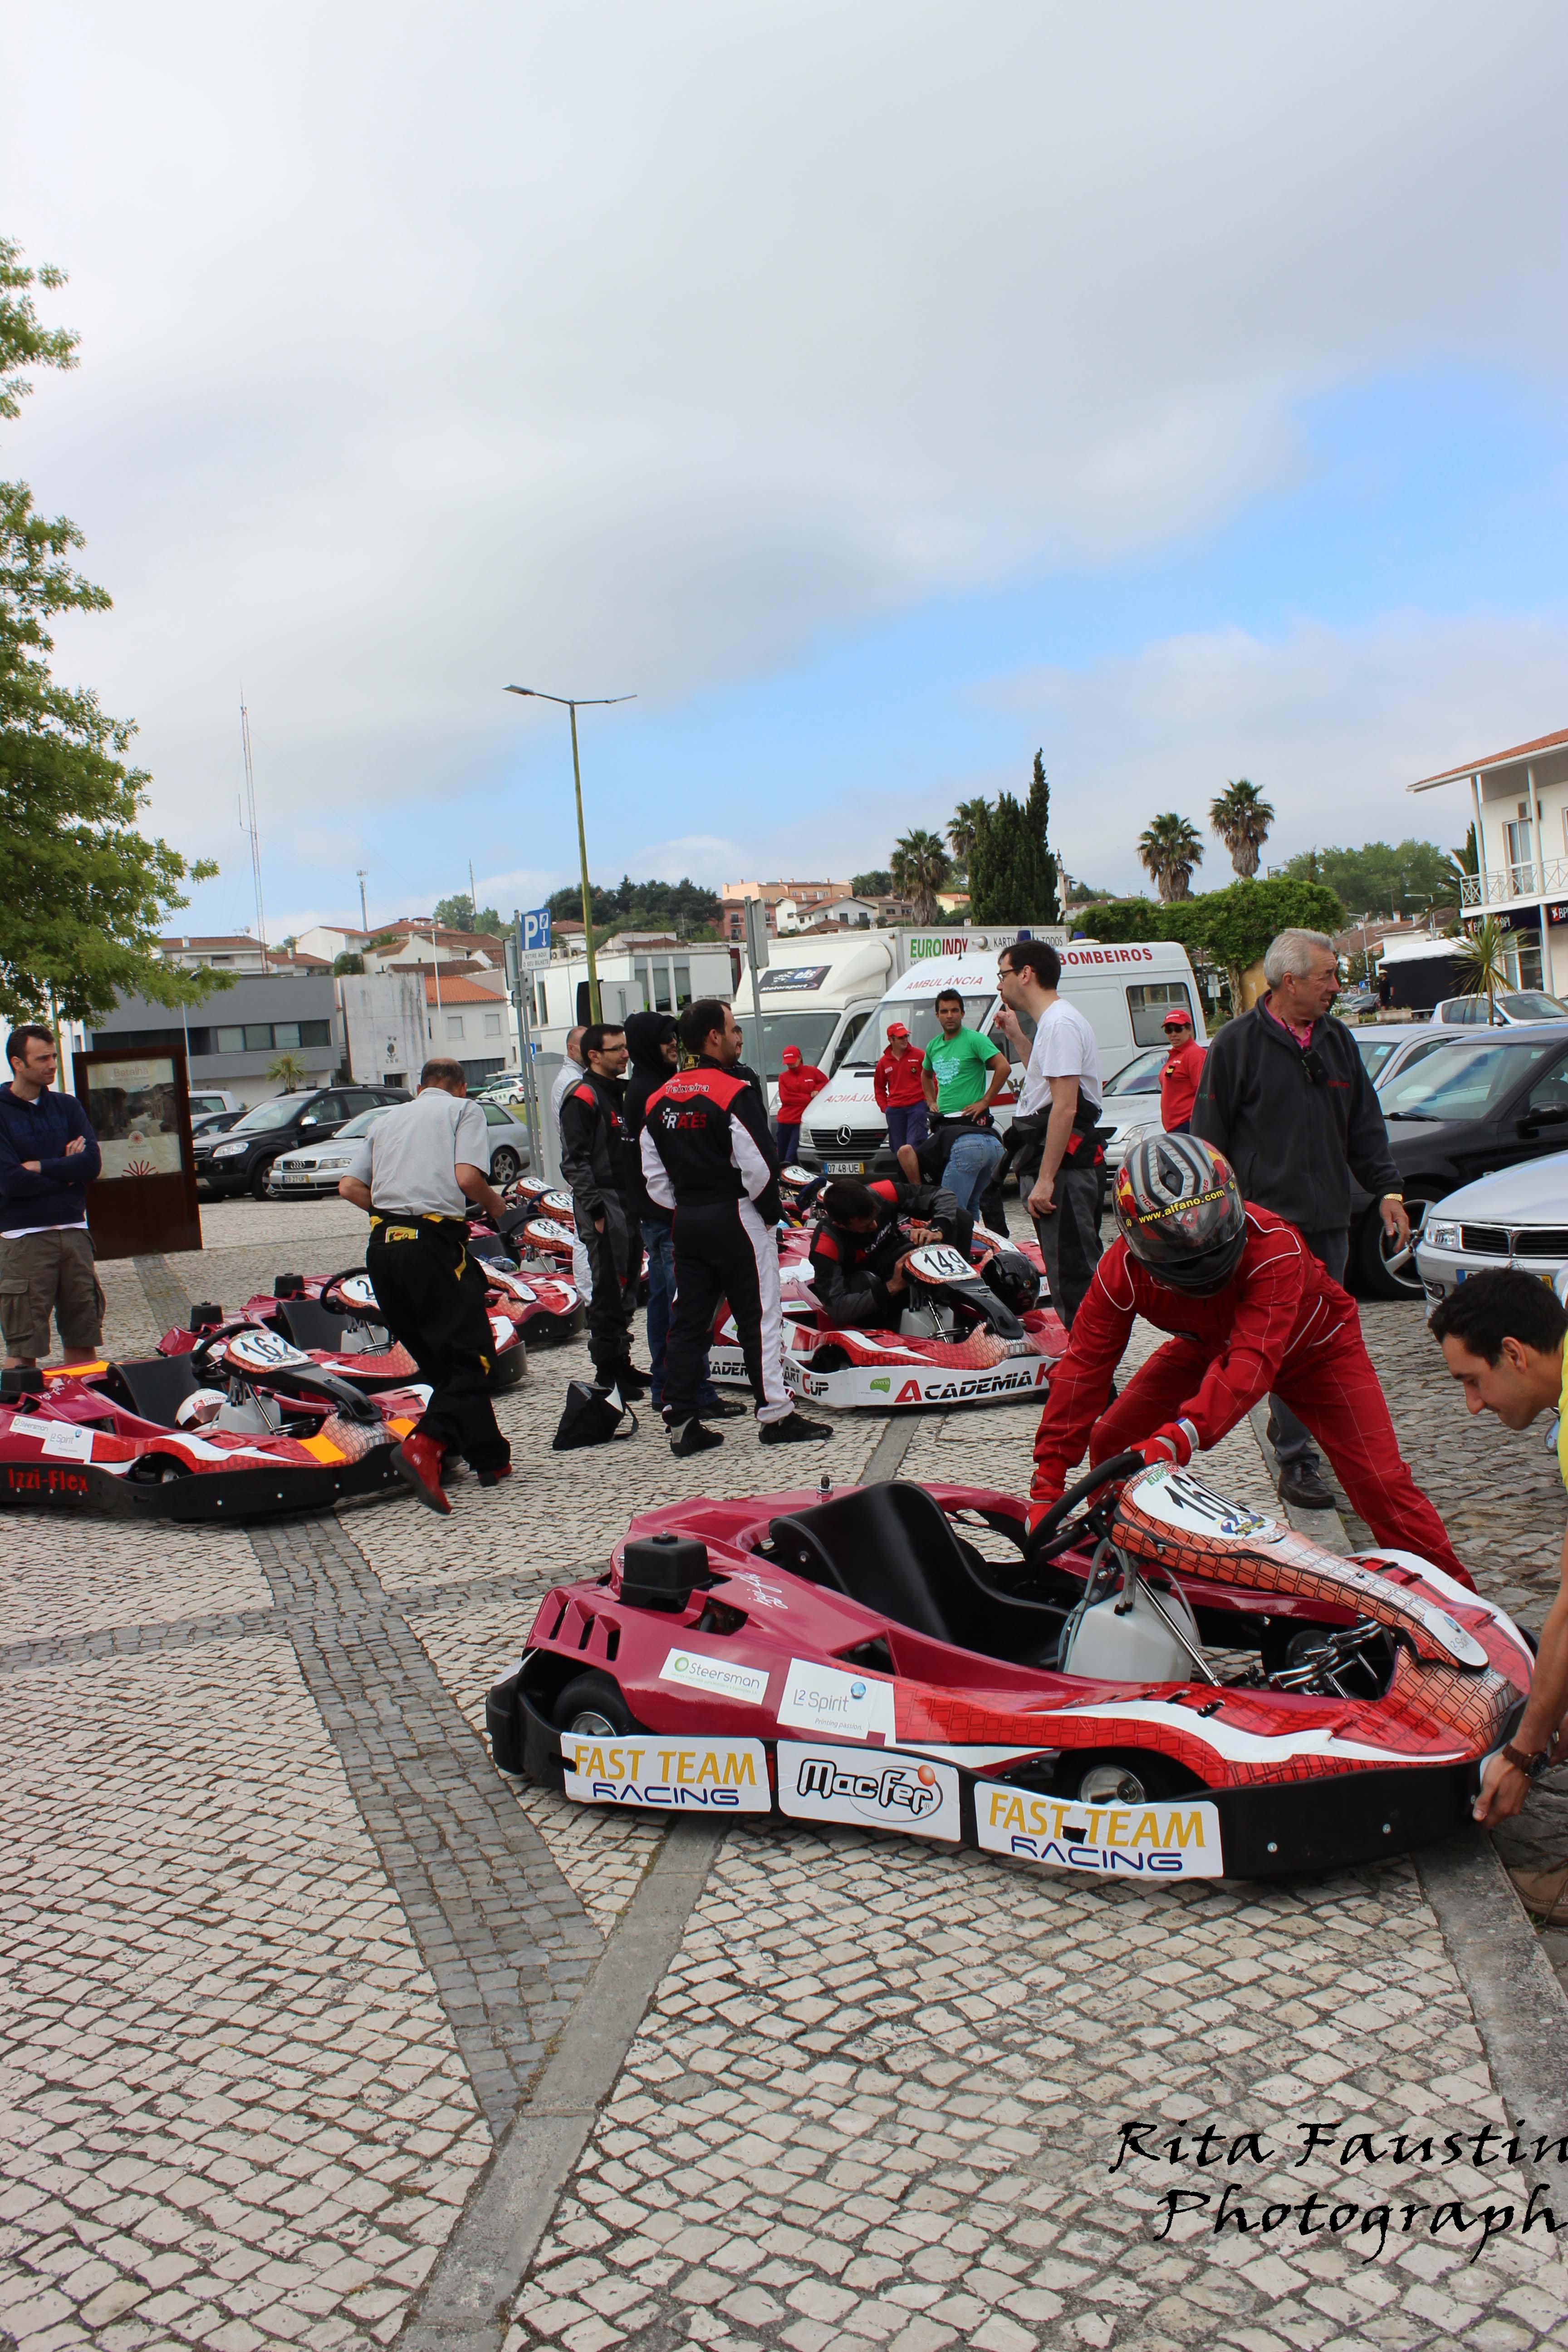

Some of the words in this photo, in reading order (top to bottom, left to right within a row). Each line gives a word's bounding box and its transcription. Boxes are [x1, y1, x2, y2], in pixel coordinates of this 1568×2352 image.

[1499, 916, 1510, 928] BPI
[911, 938, 968, 958] EUROINDY
[994, 936, 1017, 948] KARTIN
[1059, 948, 1153, 965] BOMBEIROS
[905, 975, 983, 991] AMBULÂNCIA
[113, 1067, 149, 1077] Batalha
[666, 1083, 709, 1094] Teixeira
[1139, 1188, 1225, 1224] www.alfano.com
[924, 1250, 967, 1273] 149
[240, 1336, 299, 1358] 162
[803, 1373, 829, 1396] CUP
[894, 1371, 1032, 1403] ACADEMIA
[8, 1468, 88, 1492] Izzi-Flex
[689, 1662, 760, 1689] Steersman
[808, 1691, 849, 1712] Spirit
[815, 1718, 838, 1728] Printing
[574, 1745, 645, 1781] FAST
[657, 1750, 757, 1786] TEAM
[593, 1782, 740, 1806] RACING
[989, 1792, 1071, 1840] FAST
[1085, 1808, 1206, 1848] TEAM
[1010, 1835, 1183, 1872] RACING
